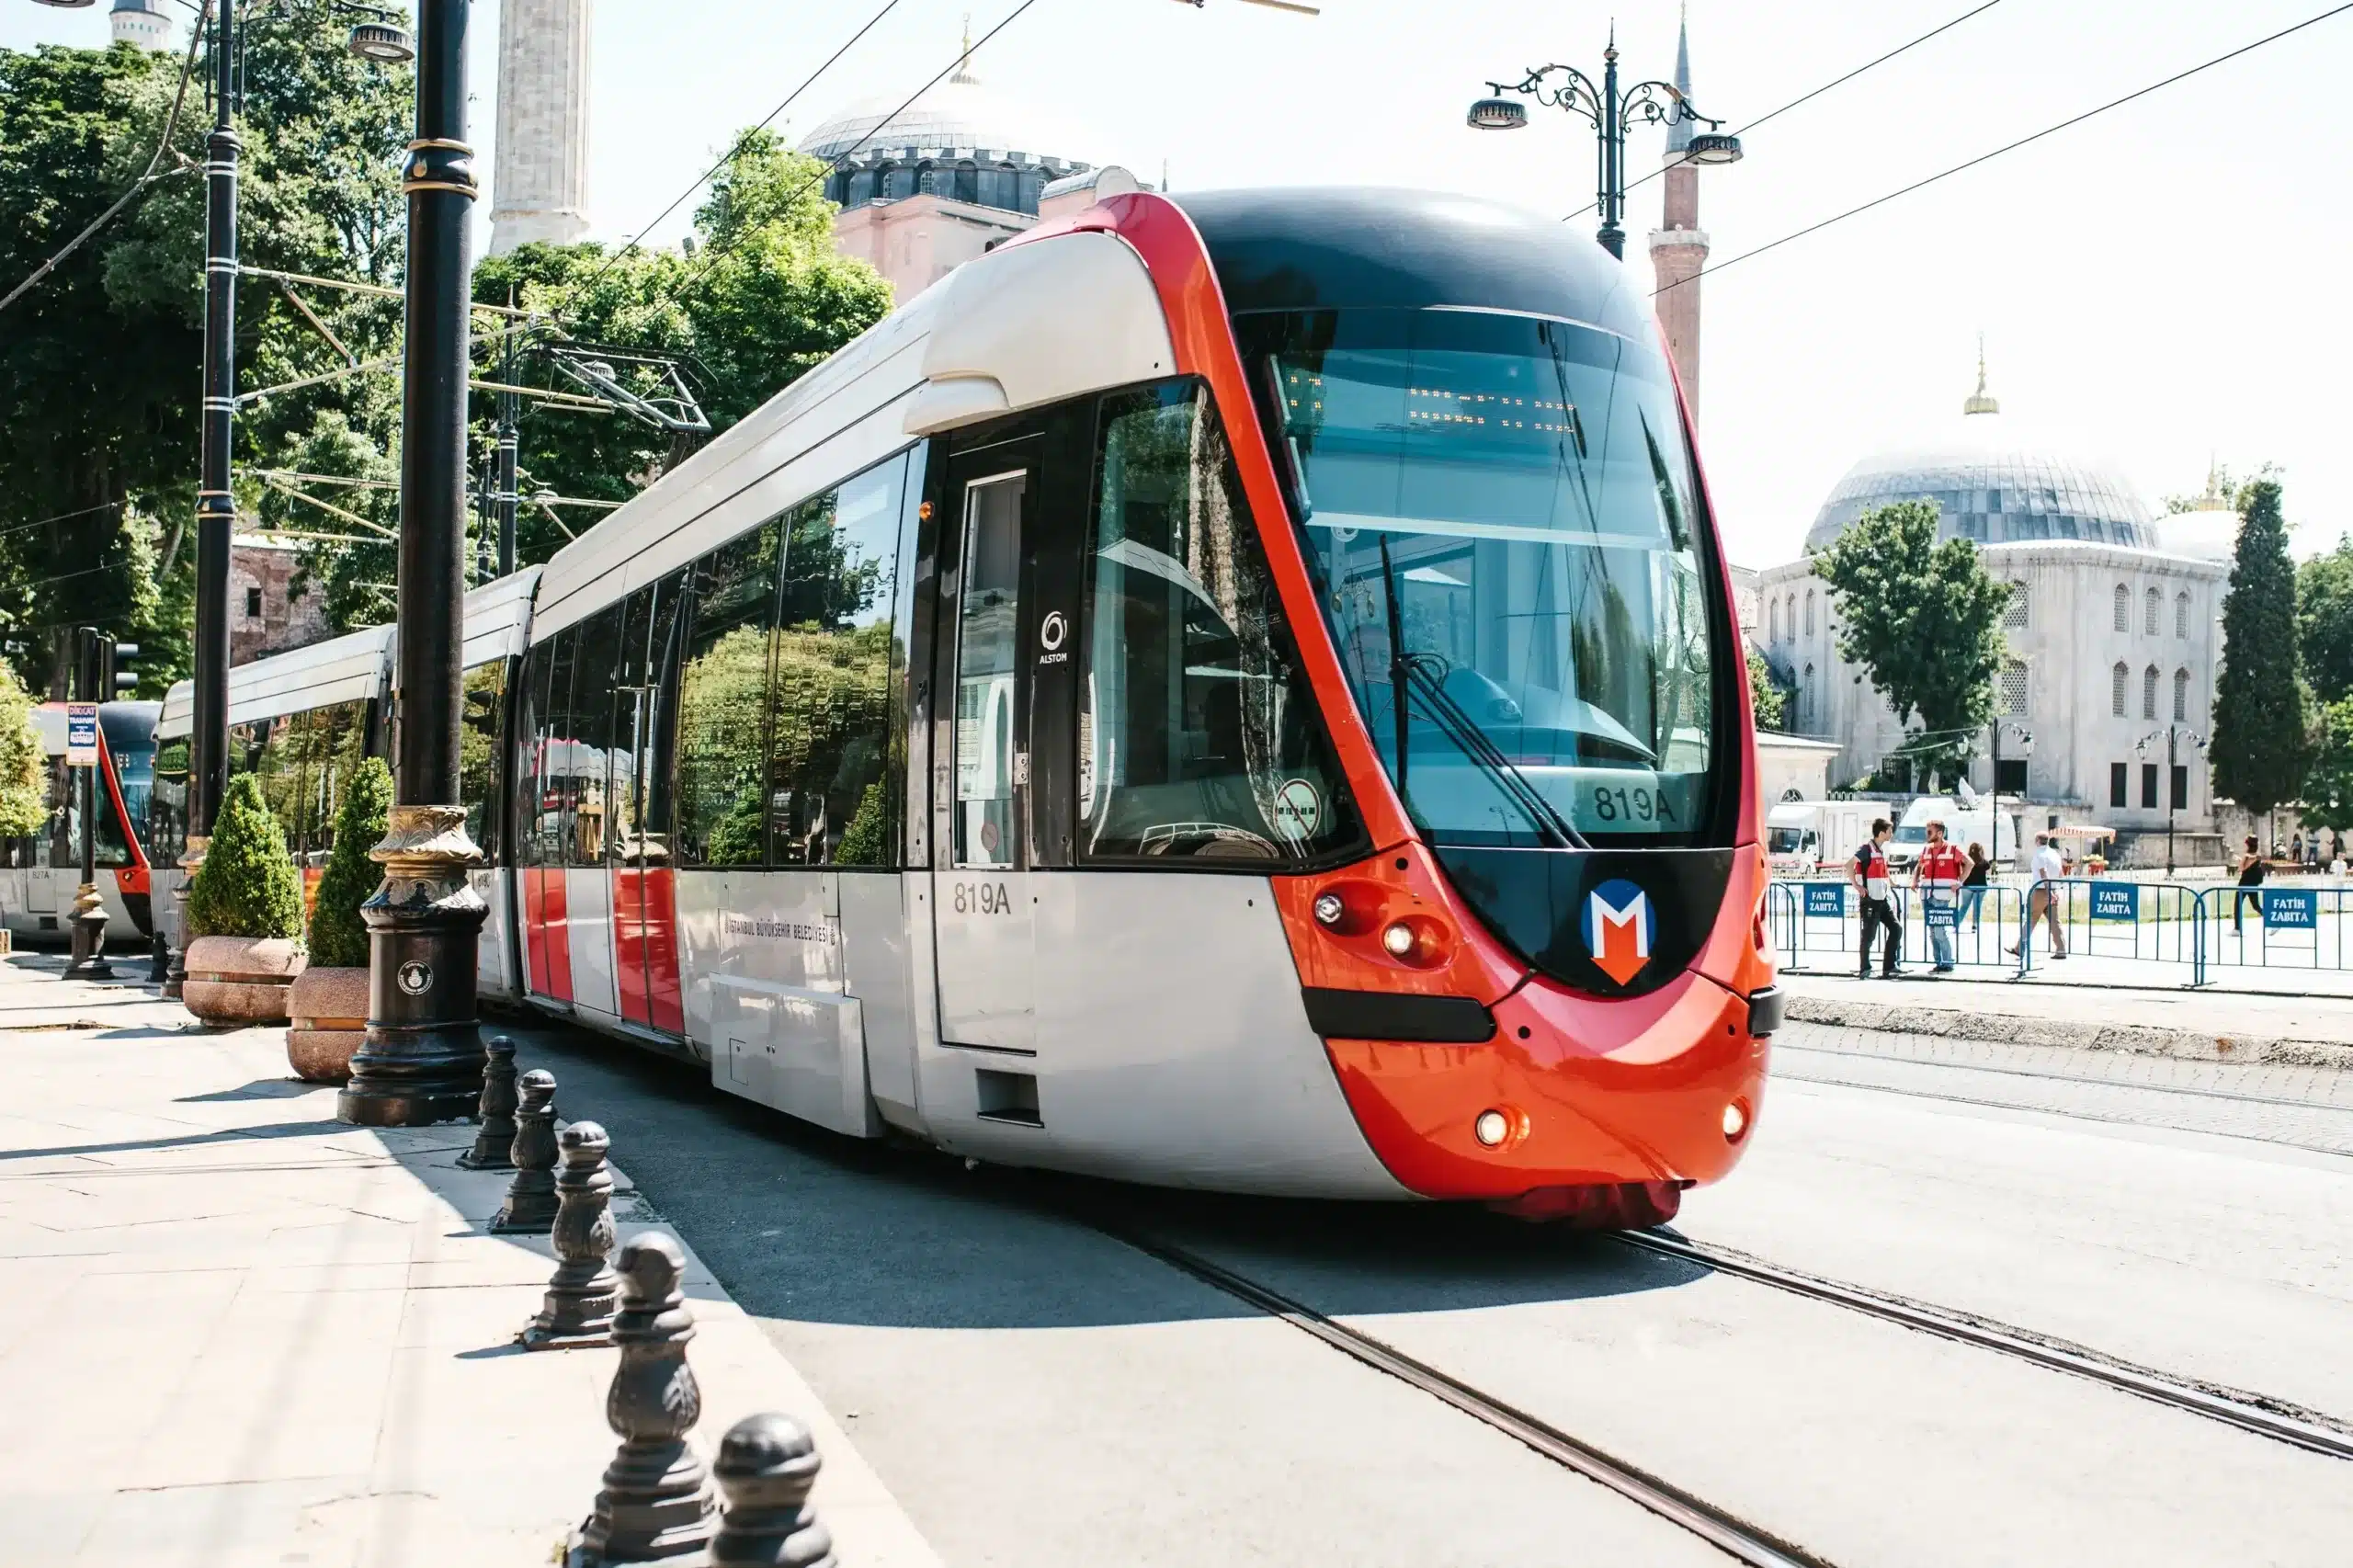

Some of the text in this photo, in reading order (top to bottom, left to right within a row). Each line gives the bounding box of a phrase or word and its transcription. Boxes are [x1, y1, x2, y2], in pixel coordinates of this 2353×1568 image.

[1039, 652, 1068, 665] ALSTOM
[1594, 786, 1677, 823] 819A
[954, 881, 1012, 915] 819A
[1811, 890, 1836, 902] FATİH
[2098, 890, 2129, 903] FATİH
[1809, 902, 1839, 912] ZABITA
[2096, 903, 2131, 915] ZABITA
[2272, 896, 2306, 910] FATİH
[1928, 915, 1954, 925] ZABITA
[2269, 911, 2310, 923] ZABITA
[1590, 890, 1649, 959] M
